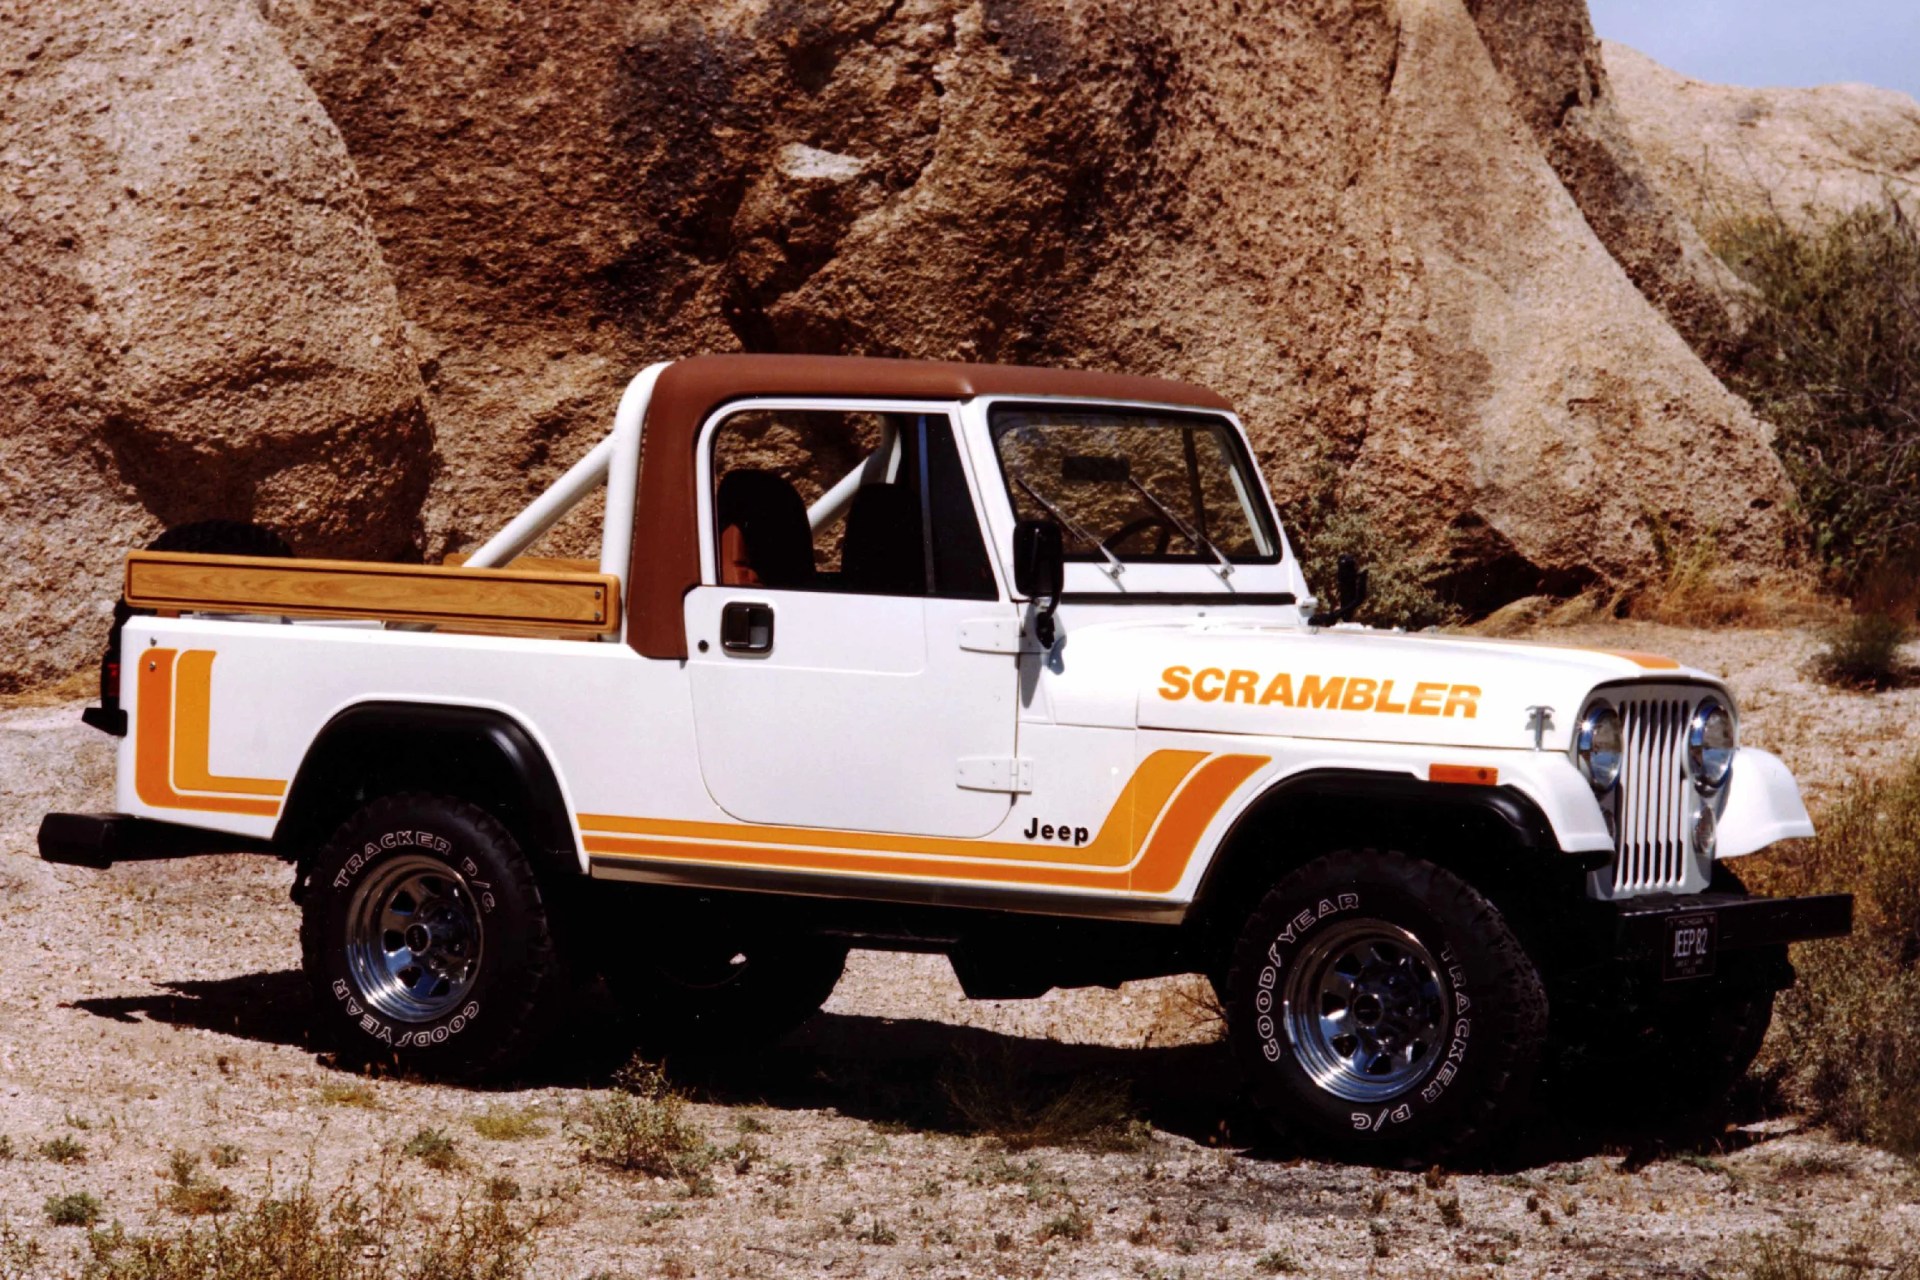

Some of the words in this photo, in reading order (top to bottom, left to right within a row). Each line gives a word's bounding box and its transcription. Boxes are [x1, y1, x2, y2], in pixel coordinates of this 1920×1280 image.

[1158, 665, 1482, 718] SCRAMBLER
[1024, 817, 1089, 846] Jeep
[333, 830, 451, 889] TRACKER
[1673, 929, 1695, 958] JEEP
[1695, 927, 1708, 954] 82
[1421, 941, 1470, 1102] TRACKER
